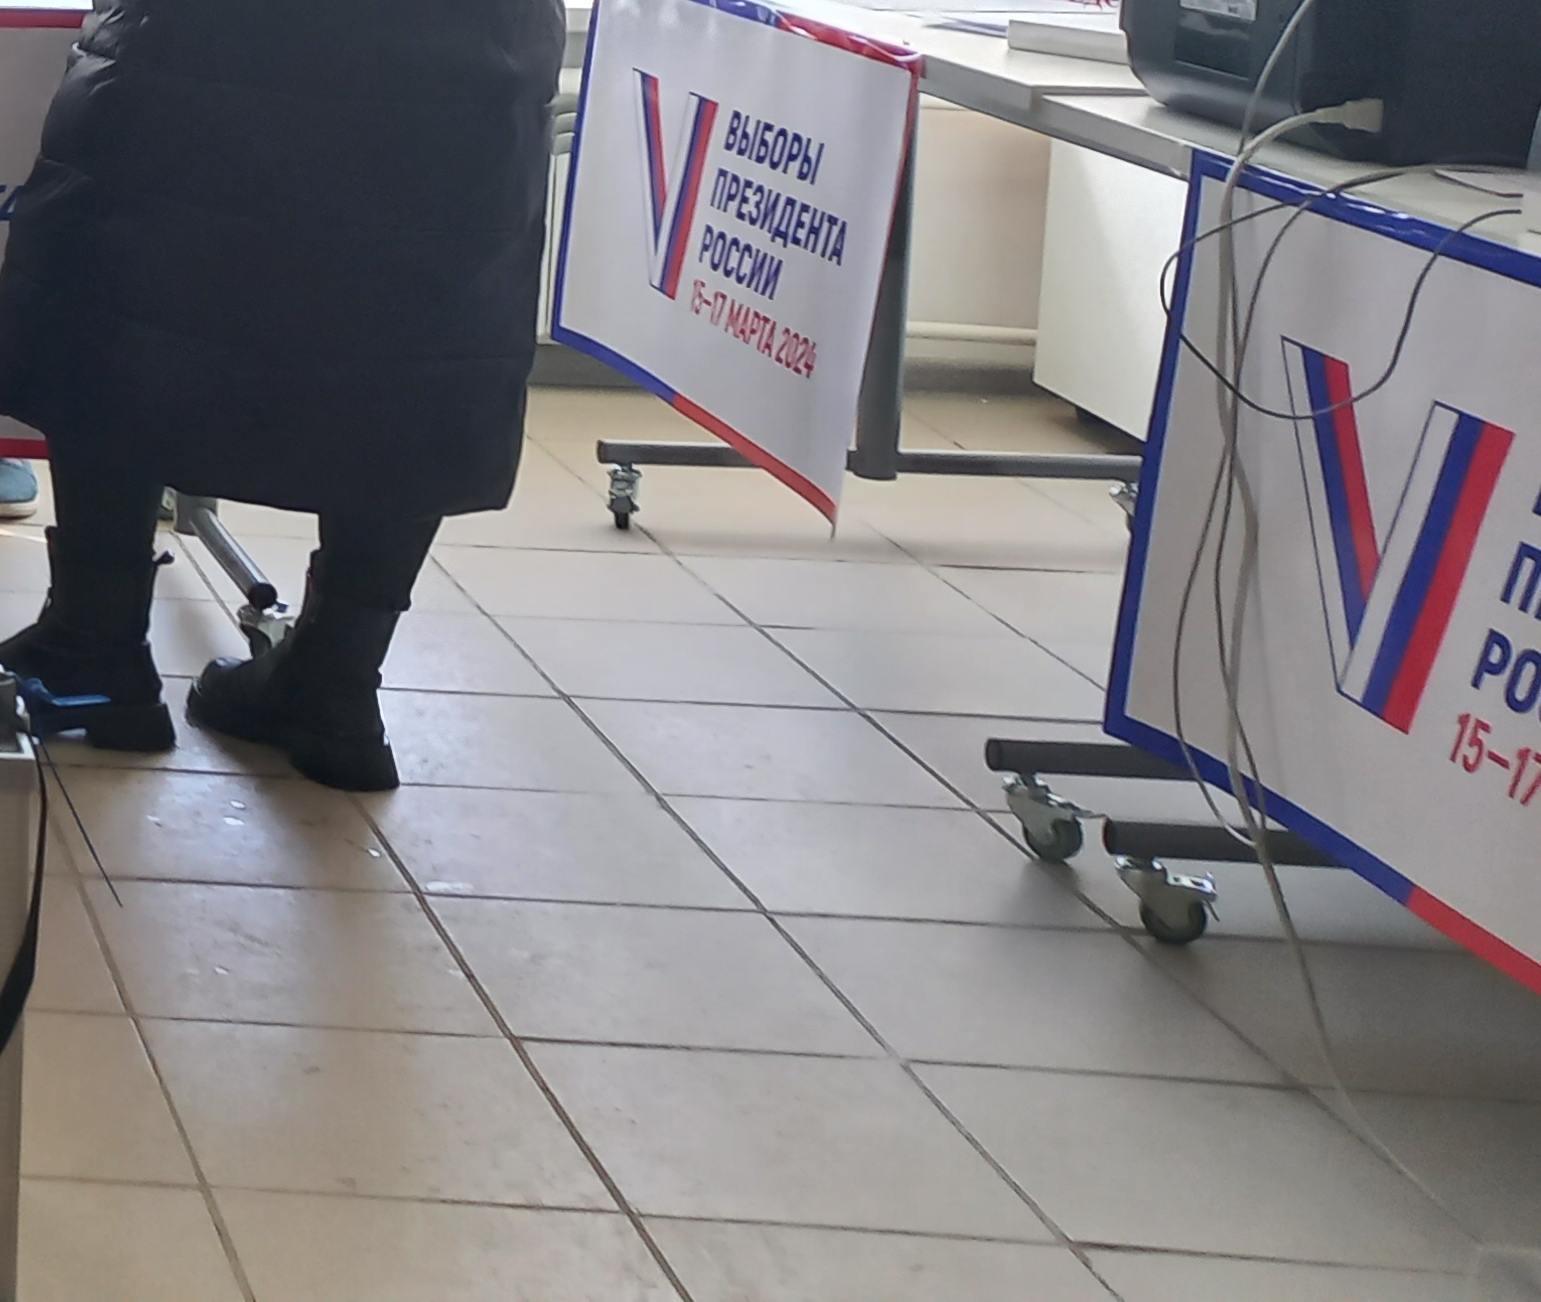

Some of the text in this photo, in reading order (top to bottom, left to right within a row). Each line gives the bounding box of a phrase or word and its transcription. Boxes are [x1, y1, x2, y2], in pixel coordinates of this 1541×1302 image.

[723, 108, 826, 187] ВЫБОРЫ
[710, 167, 849, 267] ПРЕЗИДЕНТА
[698, 224, 784, 302] РОССИИ
[724, 296, 777, 359] МАРТА
[775, 327, 817, 380] 2024
